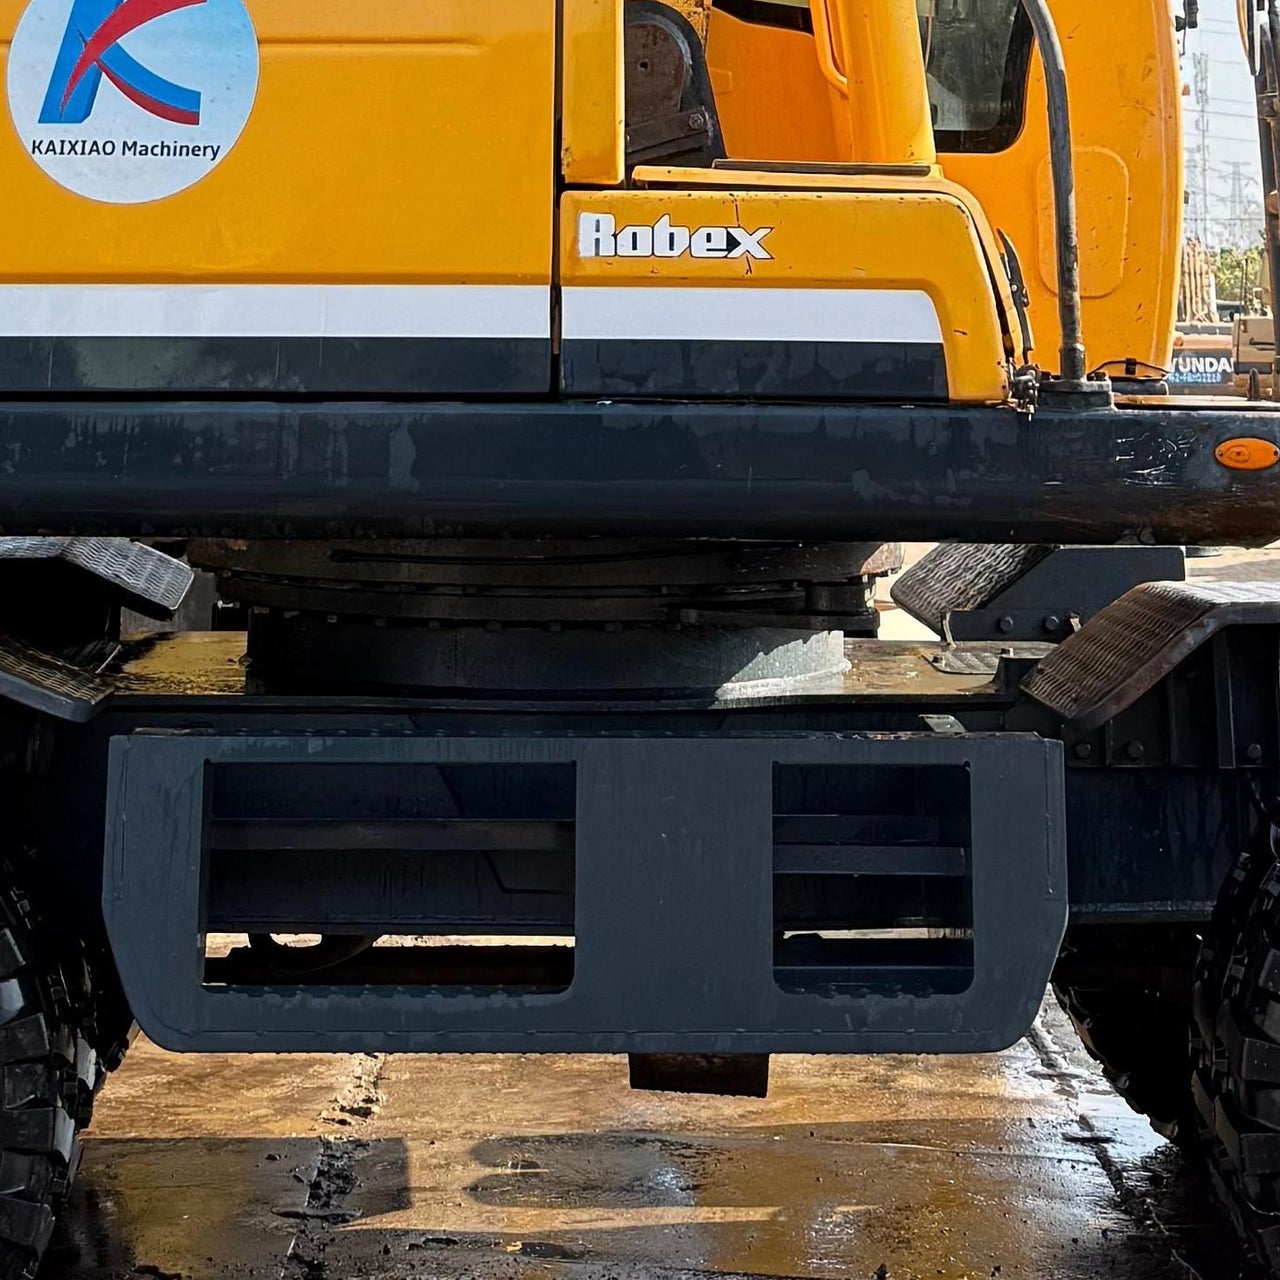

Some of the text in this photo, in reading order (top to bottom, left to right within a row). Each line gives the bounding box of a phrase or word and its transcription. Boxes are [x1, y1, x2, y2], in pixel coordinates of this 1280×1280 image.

[30, 139, 221, 162] KAIXIAO Machinery
[578, 212, 775, 260] Robex
